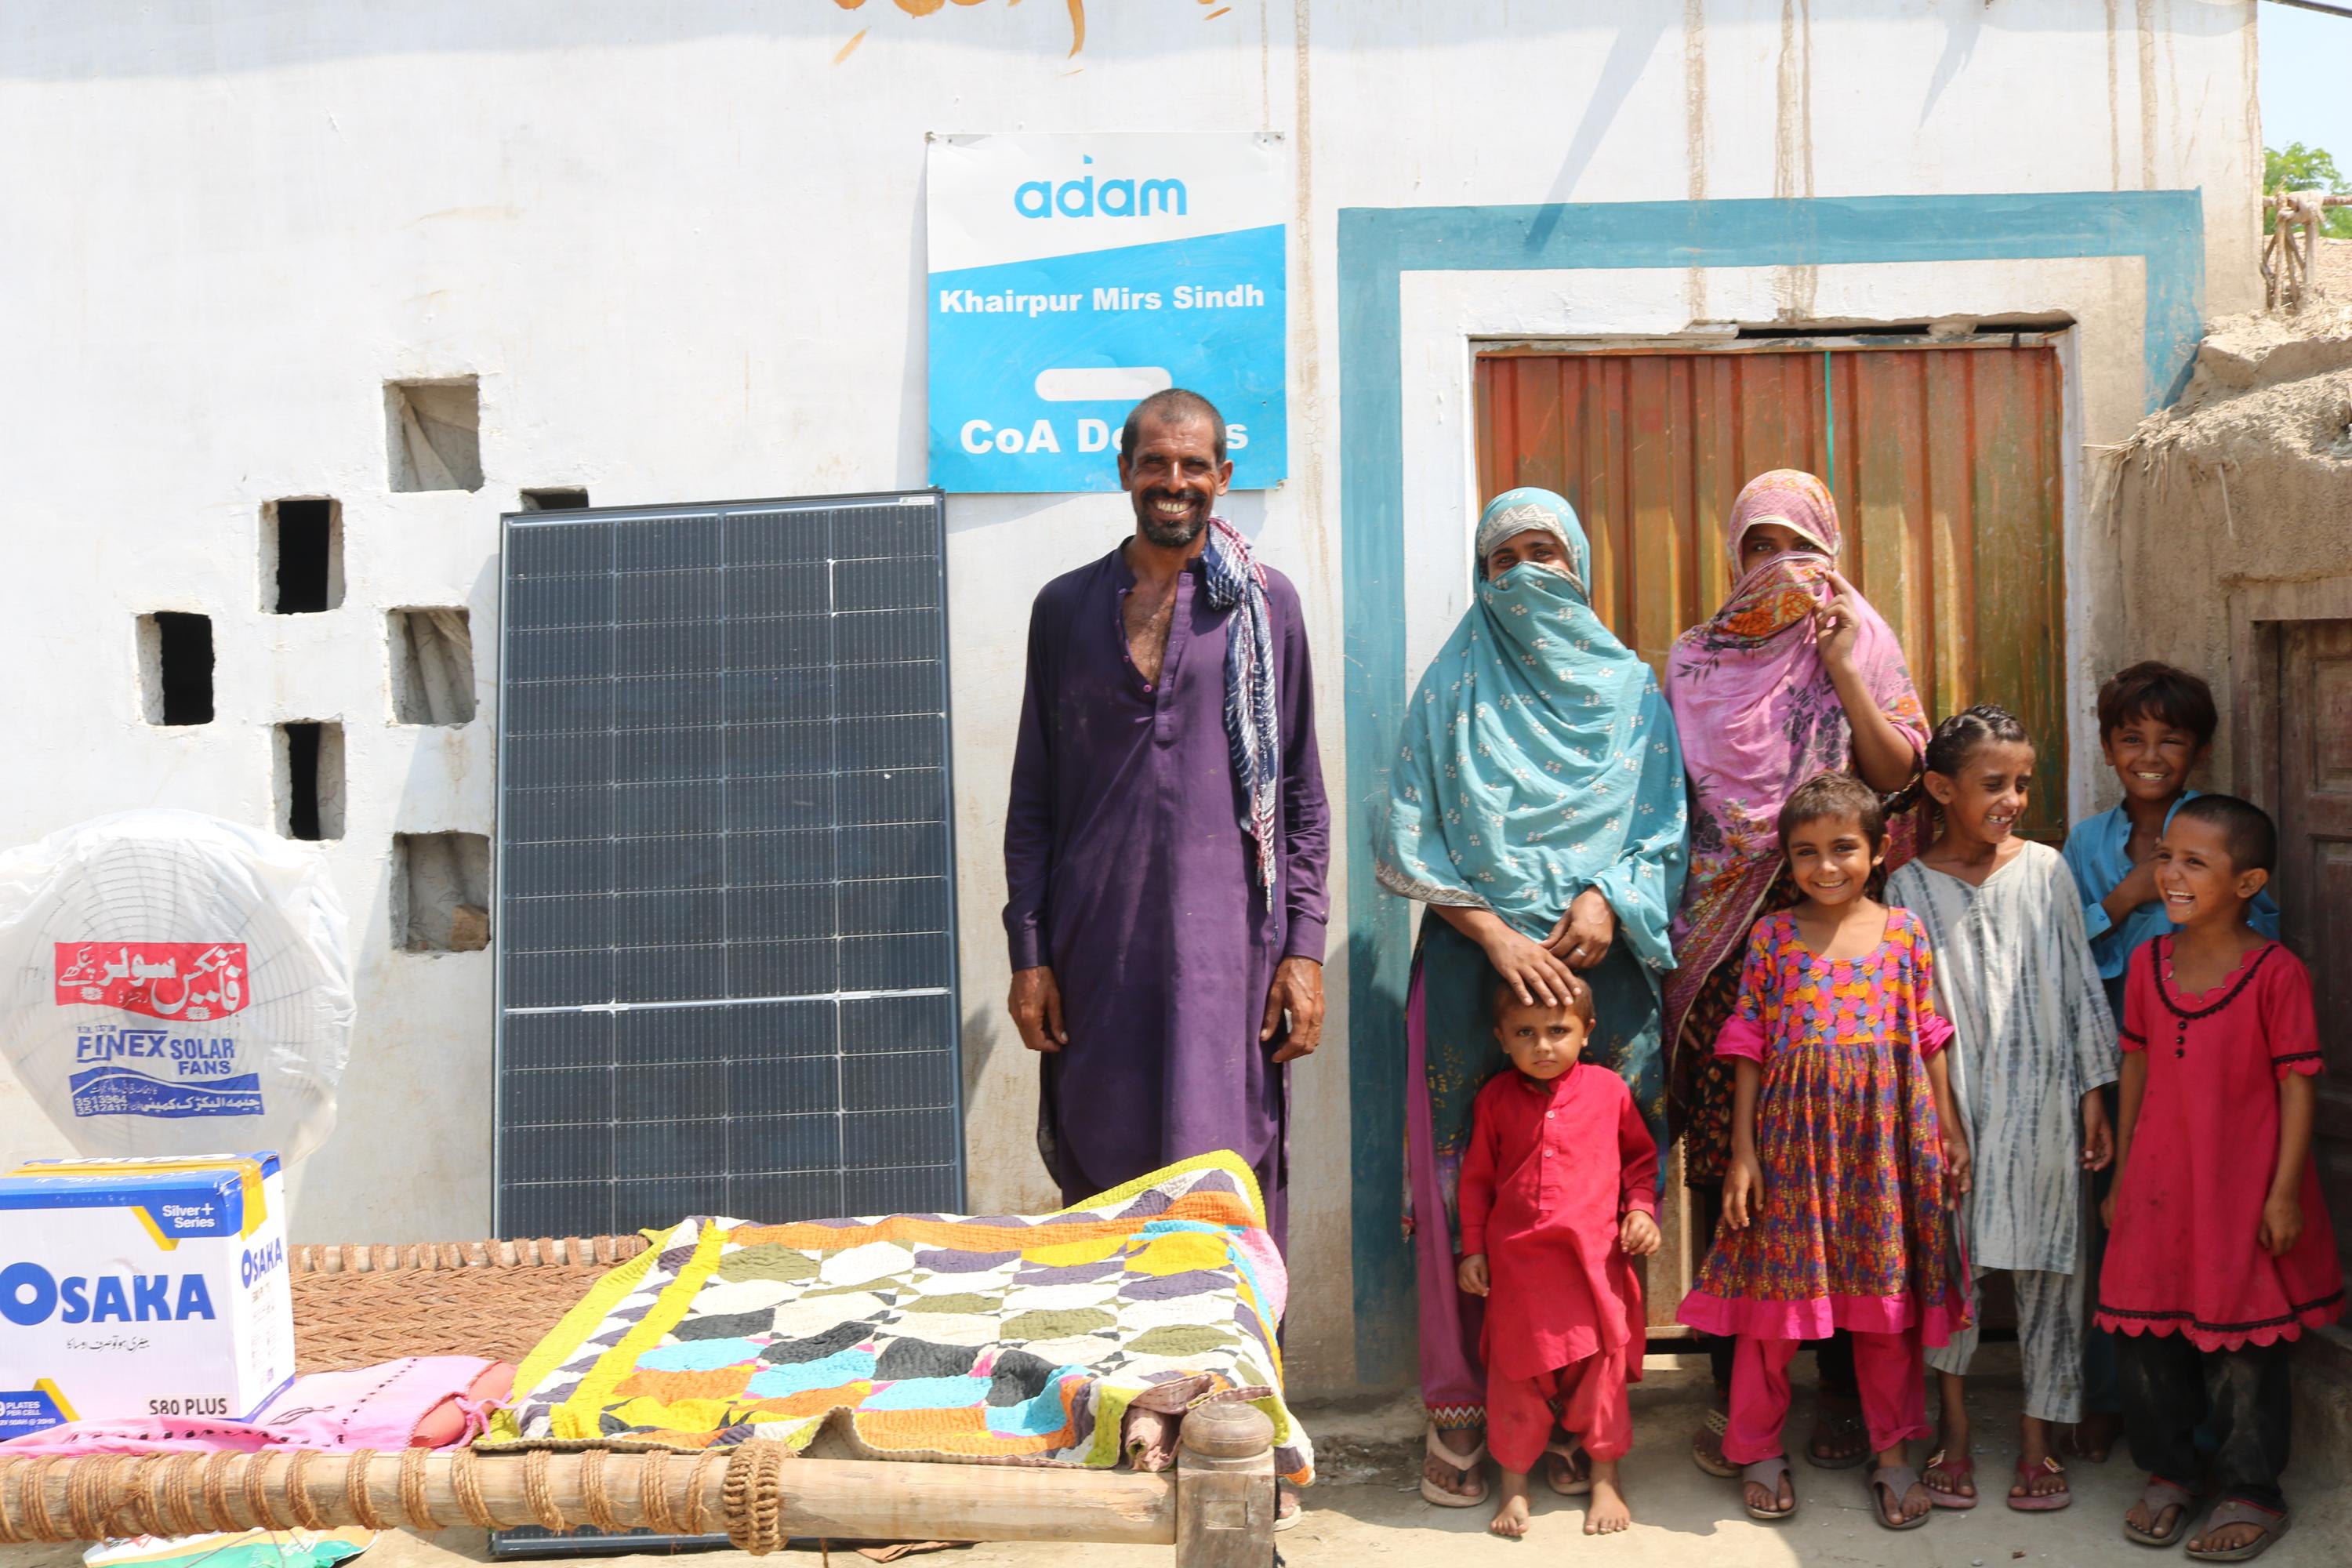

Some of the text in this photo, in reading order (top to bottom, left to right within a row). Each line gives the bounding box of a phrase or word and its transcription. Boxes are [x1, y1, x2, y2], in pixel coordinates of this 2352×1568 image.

[1014, 154, 1187, 219] adam
[940, 285, 1265, 318] Khairpur Mirs Sindh
[960, 419, 1060, 454] CoA
[96, 946, 176, 986] سولر
[78, 1030, 235, 1061] FINEX SOLAR
[178, 1061, 231, 1075] FANS
[174, 1217, 215, 1229] Series
[241, 1237, 283, 1289] OSAKA
[0, 1262, 216, 1326] OSAKA
[147, 1398, 227, 1415] S80 PLUS
